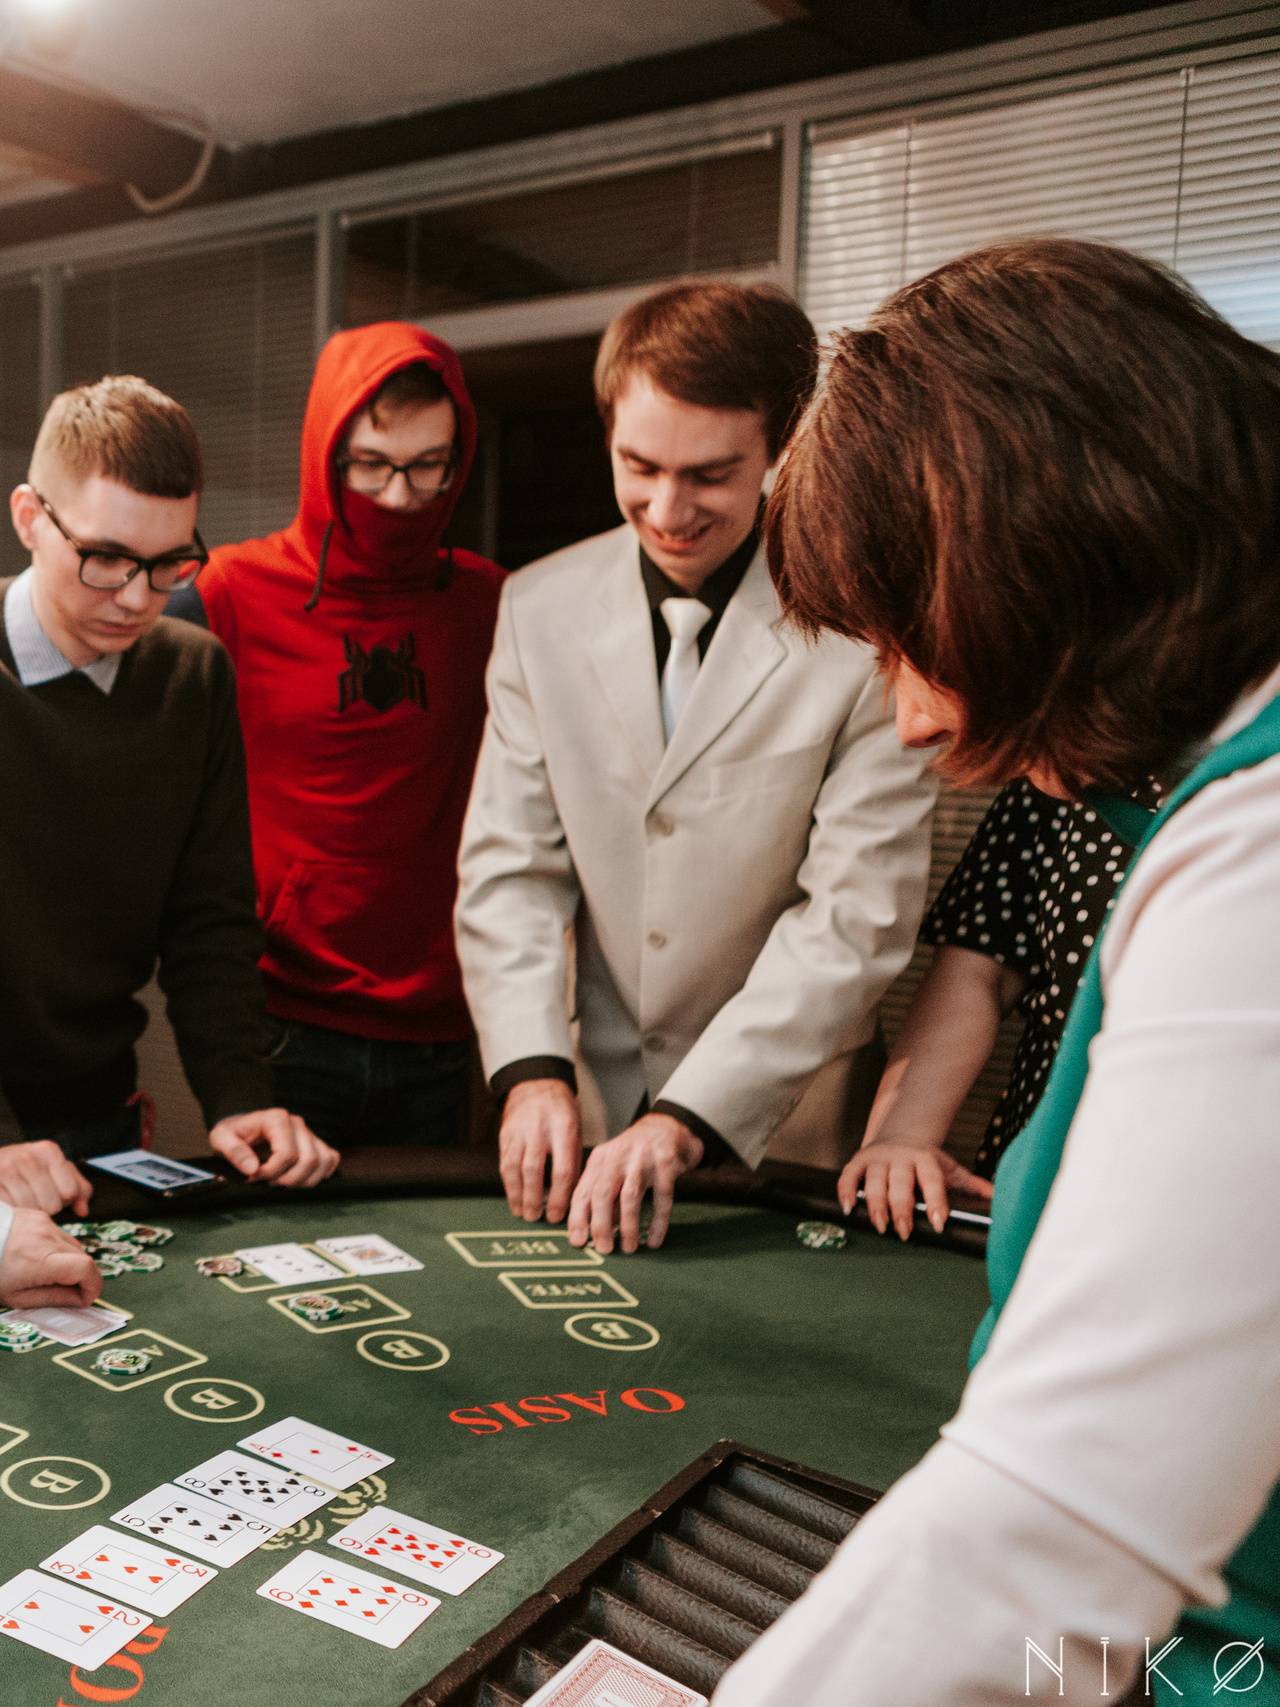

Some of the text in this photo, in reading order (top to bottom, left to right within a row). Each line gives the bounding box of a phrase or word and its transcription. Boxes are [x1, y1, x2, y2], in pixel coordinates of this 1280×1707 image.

[489, 1241, 560, 1255] BET
[525, 1283, 602, 1297] ANTE
[591, 1321, 632, 1340] B
[381, 1338, 425, 1360] B
[190, 1387, 240, 1411] B
[448, 1387, 686, 1436] OASIS
[30, 1467, 84, 1494] B
[184, 1477, 207, 1489] 8
[303, 1485, 326, 1498] 8
[120, 1514, 146, 1527] 5
[246, 1520, 272, 1535] 5
[49, 1561, 76, 1575] 3
[181, 1564, 208, 1578] 3
[112, 1610, 141, 1627] 2
